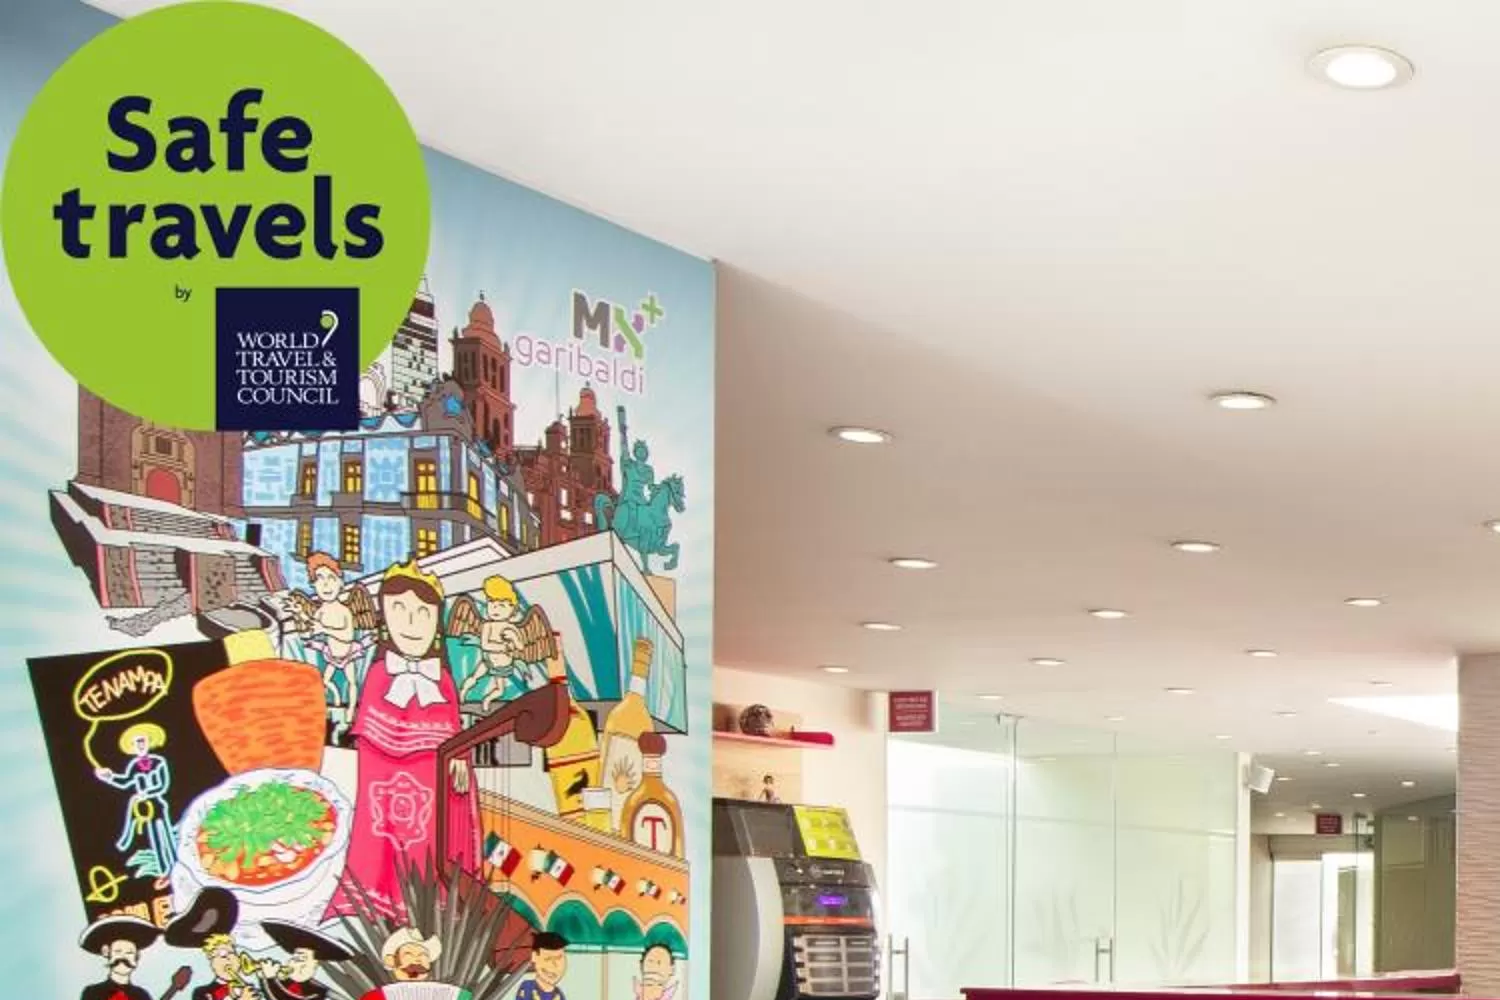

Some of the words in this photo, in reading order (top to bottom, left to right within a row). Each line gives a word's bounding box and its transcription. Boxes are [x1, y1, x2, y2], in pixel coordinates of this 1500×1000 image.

[514, 334, 645, 396] garibaldi
[79, 664, 169, 713] TENAMPA
[641, 816, 668, 851] T
